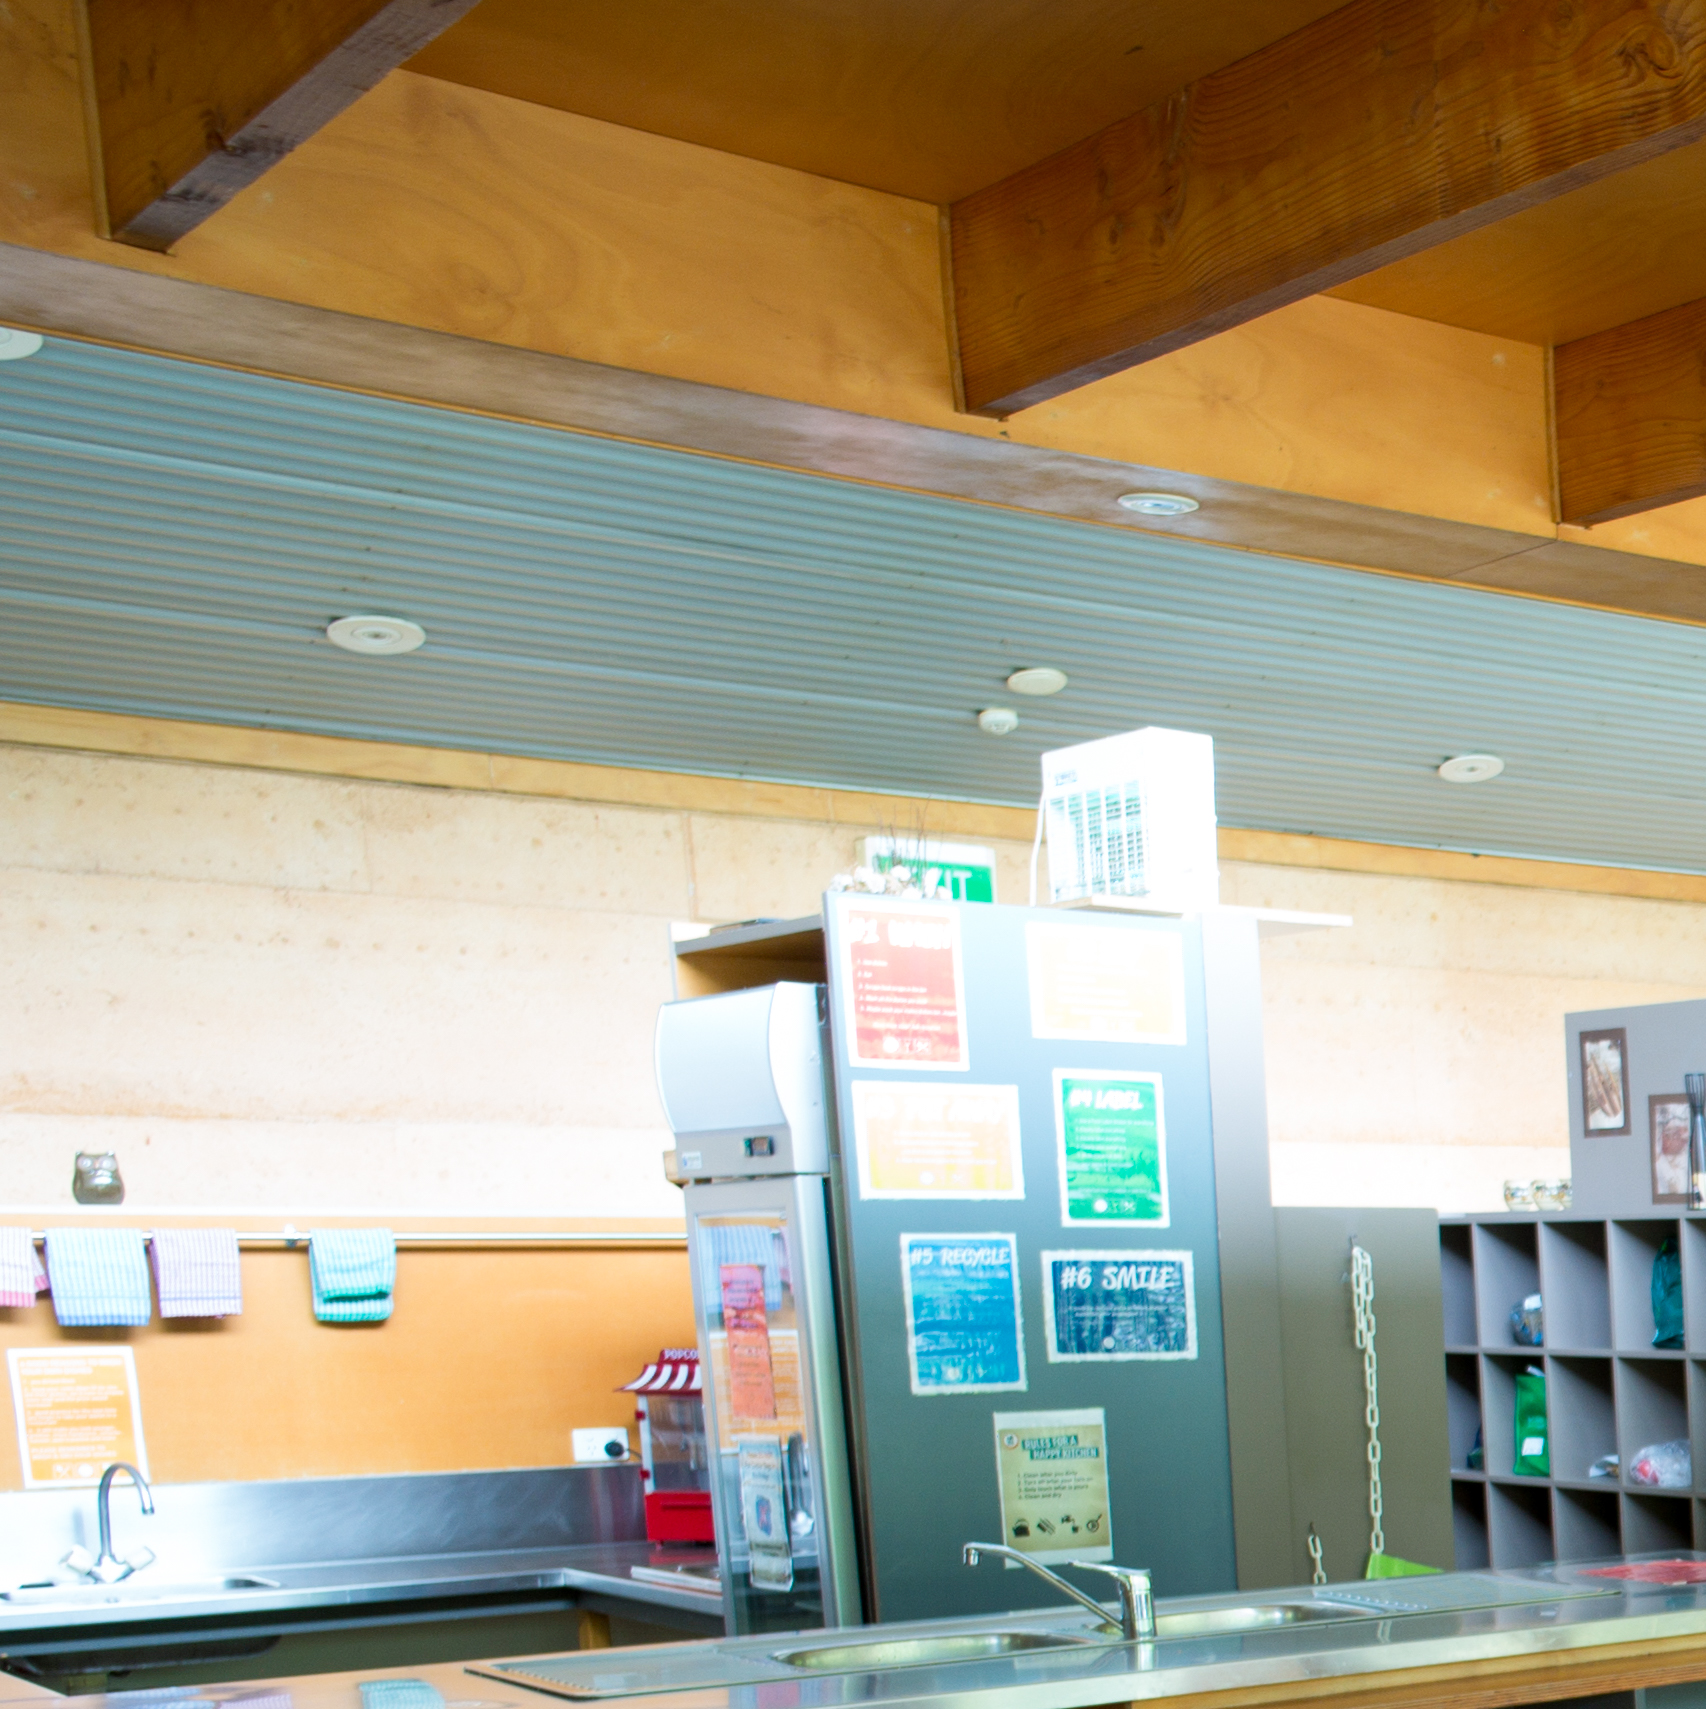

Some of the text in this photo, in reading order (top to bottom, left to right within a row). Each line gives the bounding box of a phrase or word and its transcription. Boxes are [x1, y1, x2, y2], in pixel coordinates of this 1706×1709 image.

[911, 1246, 1011, 1267] #5 RECYCLE
[1060, 1265, 1176, 1290] #6 SMILE
[664, 1348, 698, 1360] POPCO
[1025, 1435, 1077, 1449] RULES FOR A
[1033, 1446, 1097, 1459] HAPPY KITCHEN
